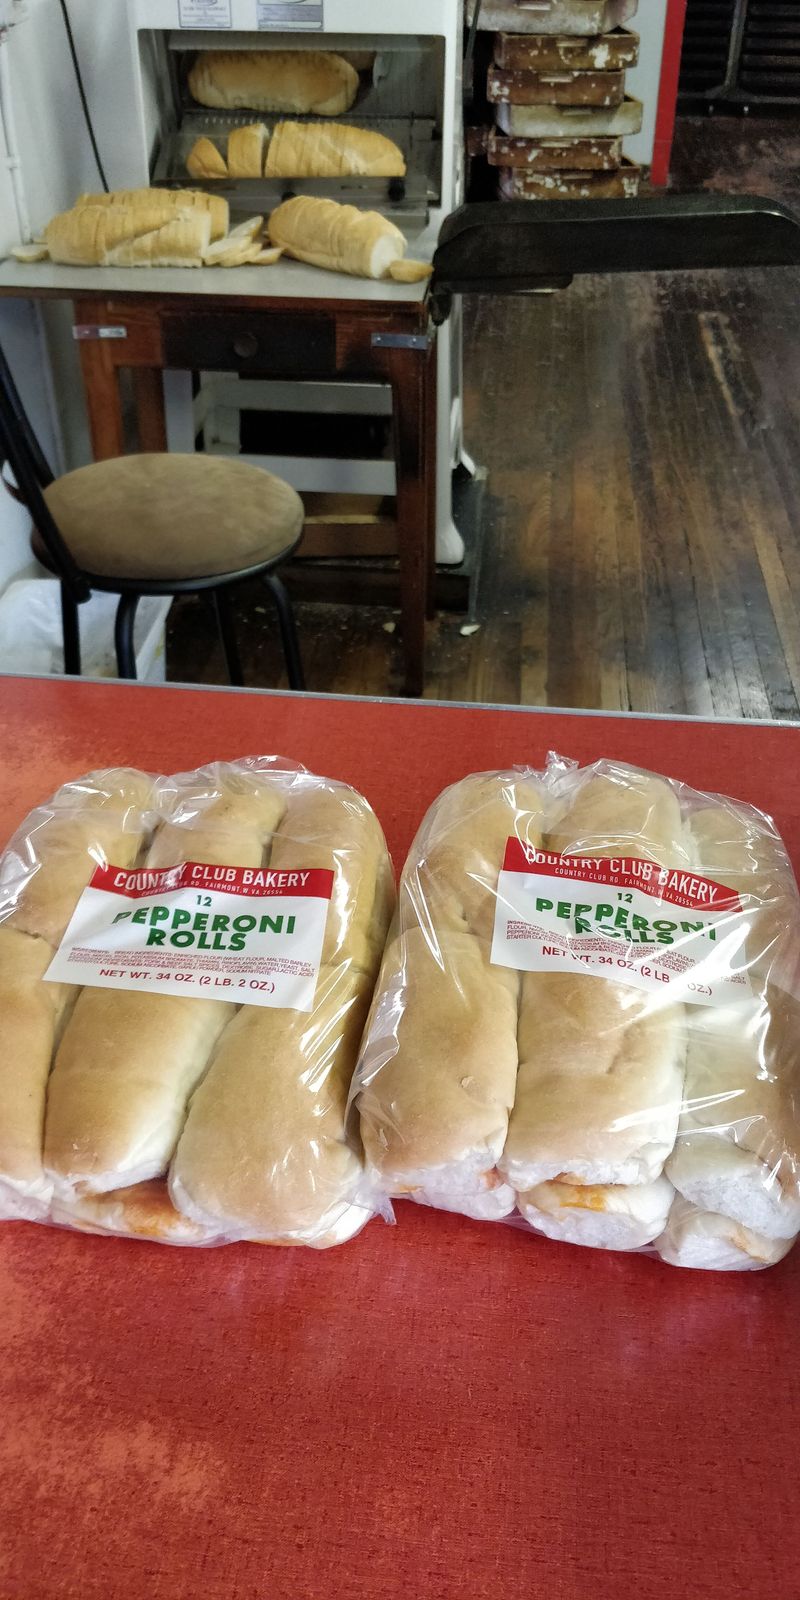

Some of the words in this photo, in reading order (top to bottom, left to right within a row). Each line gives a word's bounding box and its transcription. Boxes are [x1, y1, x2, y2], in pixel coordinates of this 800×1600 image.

[113, 864, 188, 891] COUNTY
[191, 864, 237, 882] CLUB
[242, 869, 310, 888] BAKERY
[554, 867, 586, 878] COUNTRY
[588, 872, 607, 881] CLUB
[610, 858, 653, 881] CLUB
[657, 868, 718, 904] BAKERY
[196, 894, 212, 907] 12
[617, 892, 633, 904] 12
[111, 905, 296, 934] PEPPERONI
[536, 897, 716, 941] PEPPERONI
[575, 916, 675, 945] ROLLS
[146, 927, 247, 951] ROLLS
[542, 945, 569, 957] NET
[598, 956, 613, 965] 34
[616, 959, 638, 972] OZ.
[640, 965, 652, 977] (2
[99, 968, 127, 978] NET
[130, 971, 152, 980] WT.
[155, 973, 171, 981] 34
[174, 974, 196, 983] OZ.
[199, 975, 212, 986] (2
[214, 977, 235, 987] LB.
[238, 978, 246, 988] 2
[249, 979, 276, 994] OZ.)
